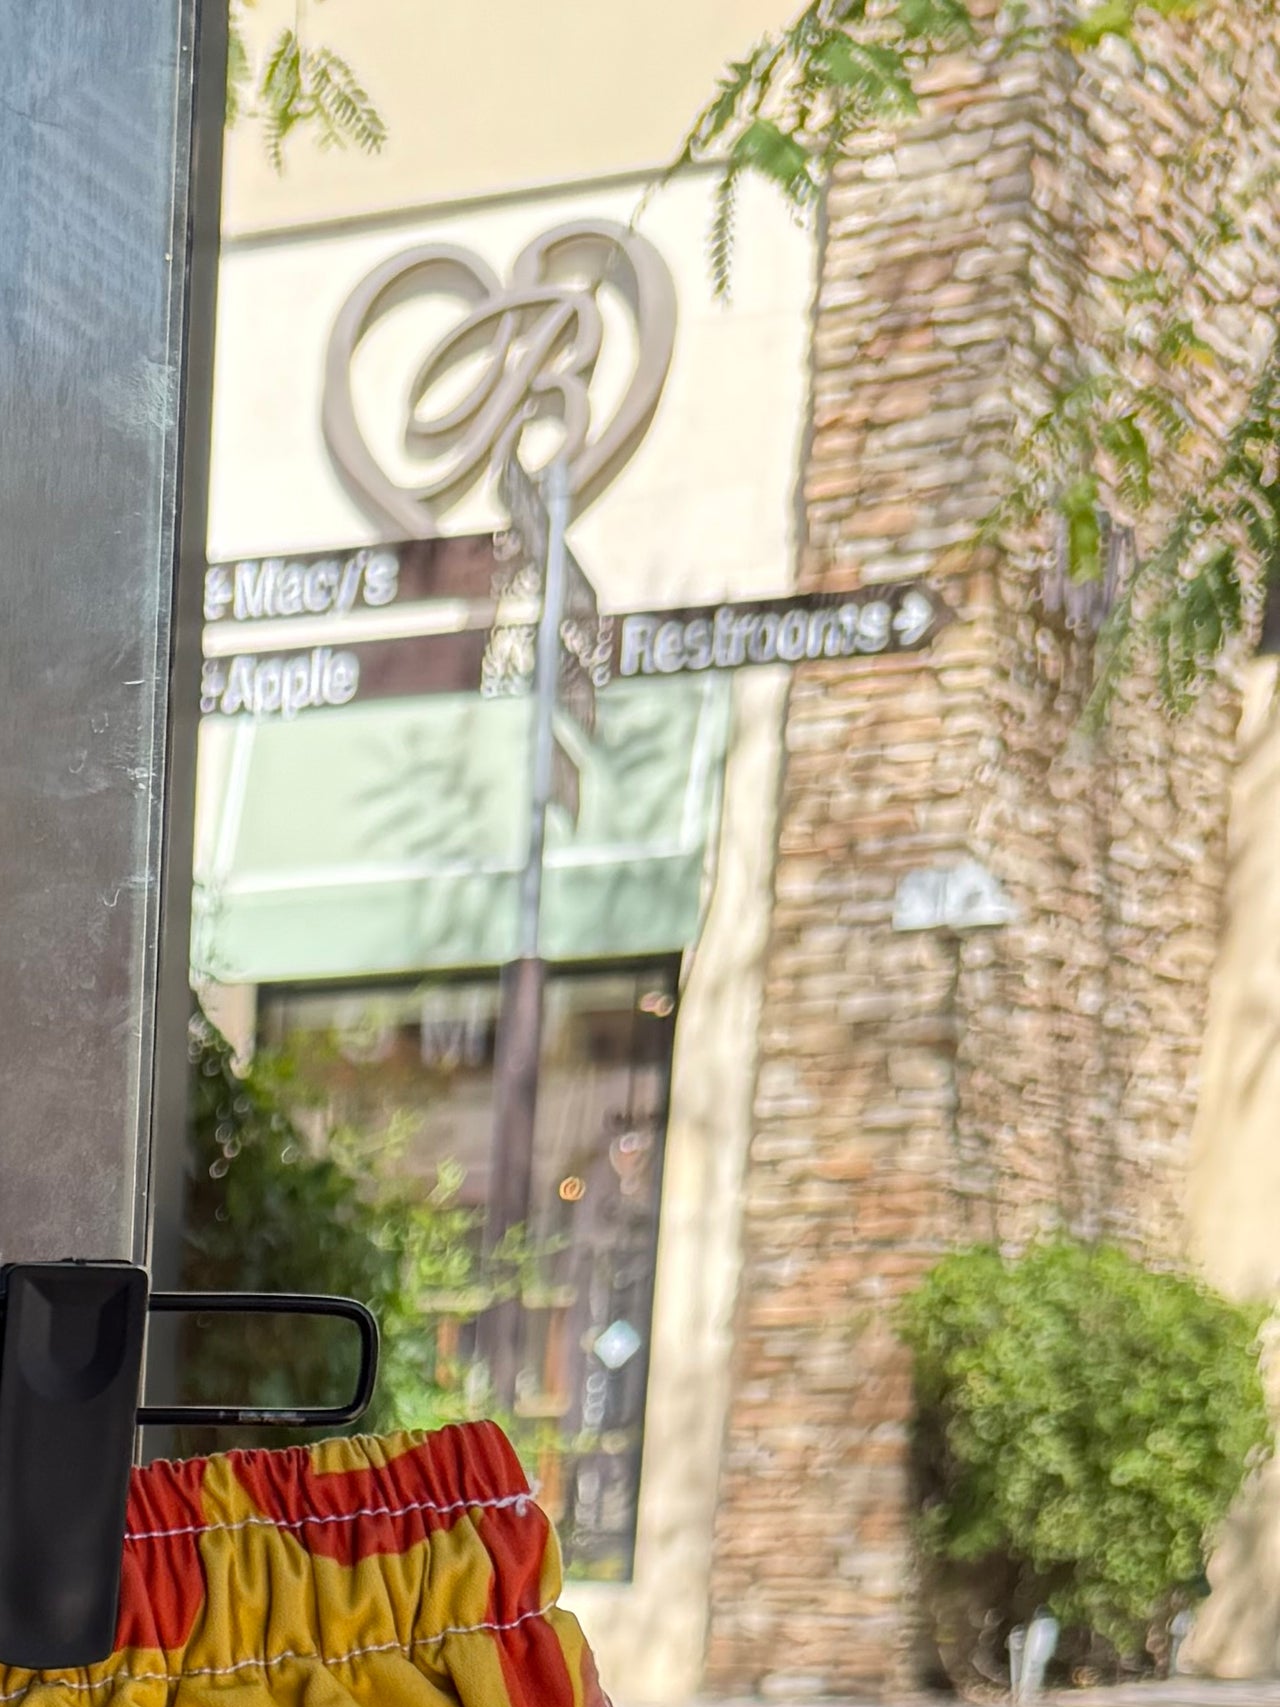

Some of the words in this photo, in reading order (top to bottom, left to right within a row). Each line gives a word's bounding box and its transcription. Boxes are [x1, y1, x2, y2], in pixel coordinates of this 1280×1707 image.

[233, 549, 400, 621] Macy's
[619, 600, 890, 676] Restrooms
[220, 646, 360, 720] Apple
